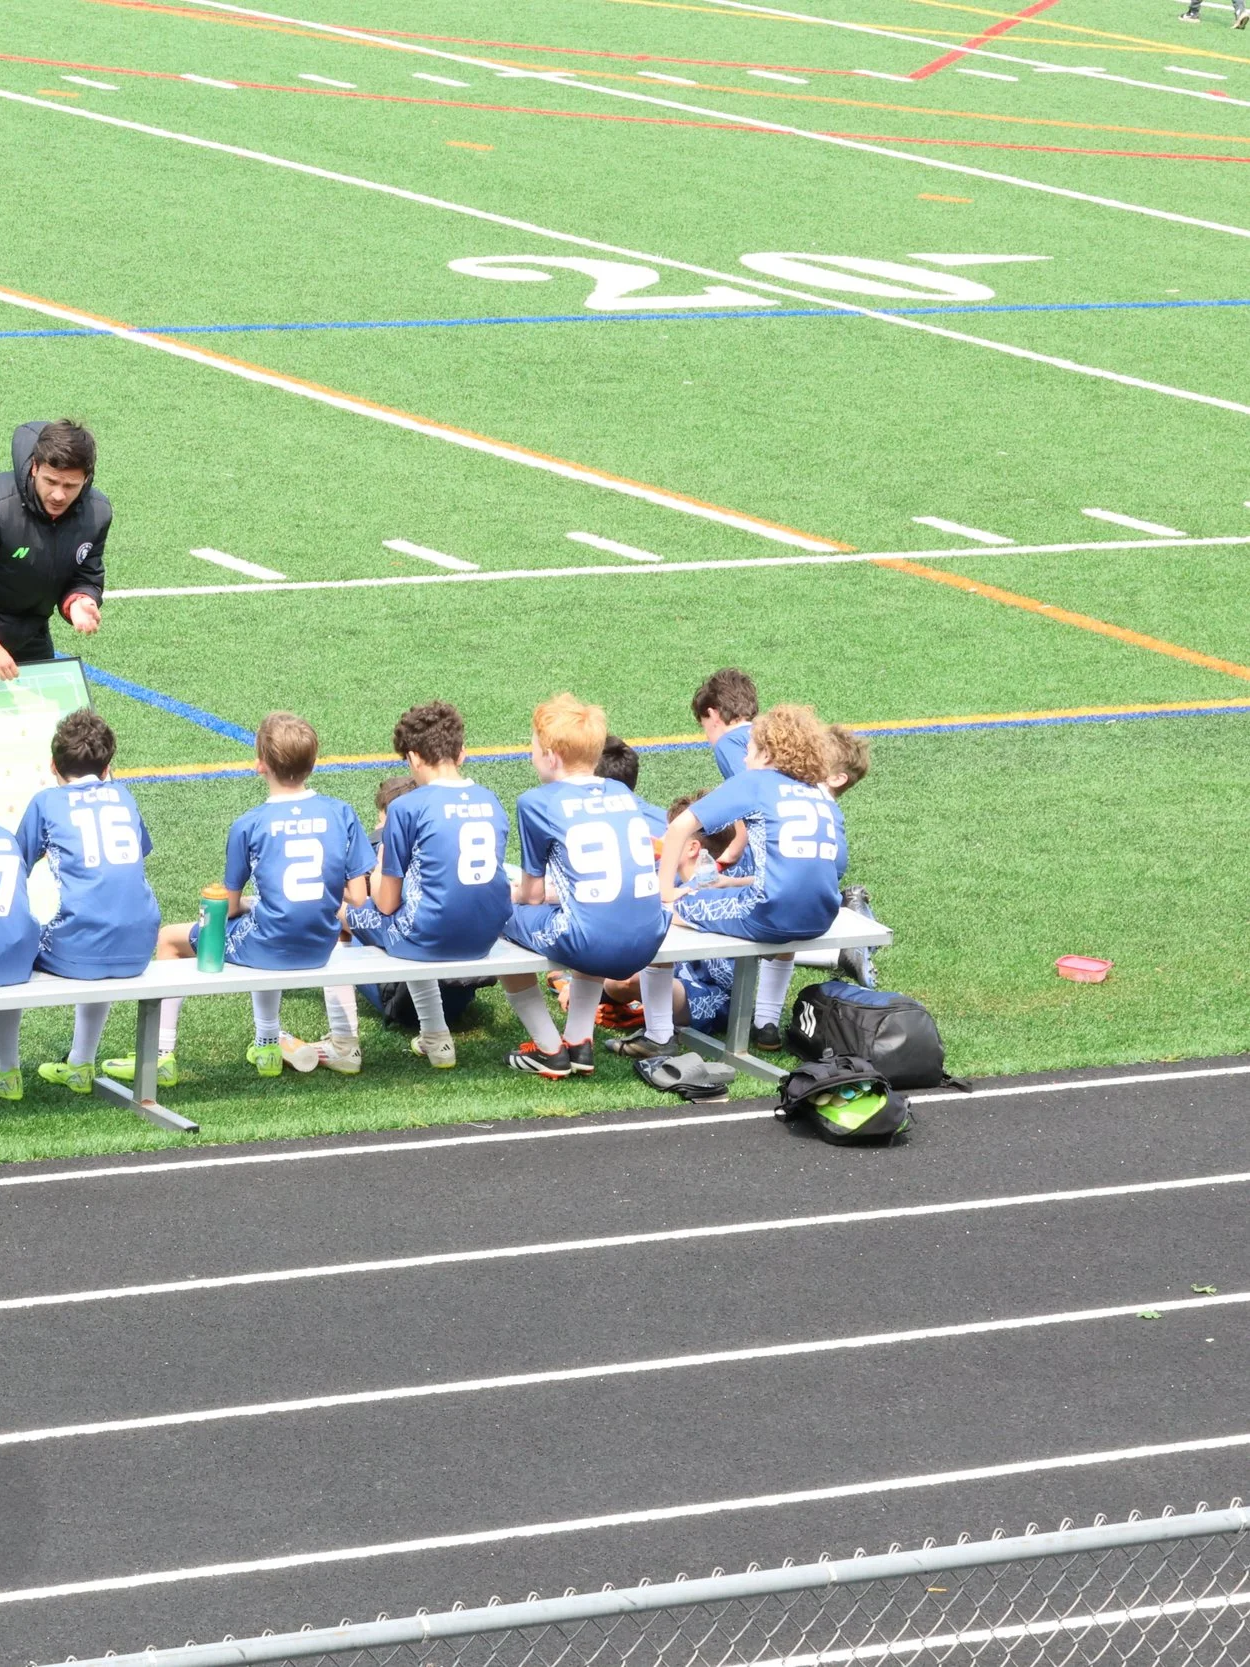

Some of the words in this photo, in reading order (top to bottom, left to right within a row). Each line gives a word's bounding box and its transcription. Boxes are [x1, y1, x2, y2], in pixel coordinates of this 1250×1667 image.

[448, 252, 996, 310] 20
[69, 805, 140, 868] 16
[270, 818, 328, 837] FCGB
[444, 803, 494, 819] FCGB
[282, 838, 324, 902] 2
[457, 821, 498, 885] 8
[565, 817, 660, 903] 99
